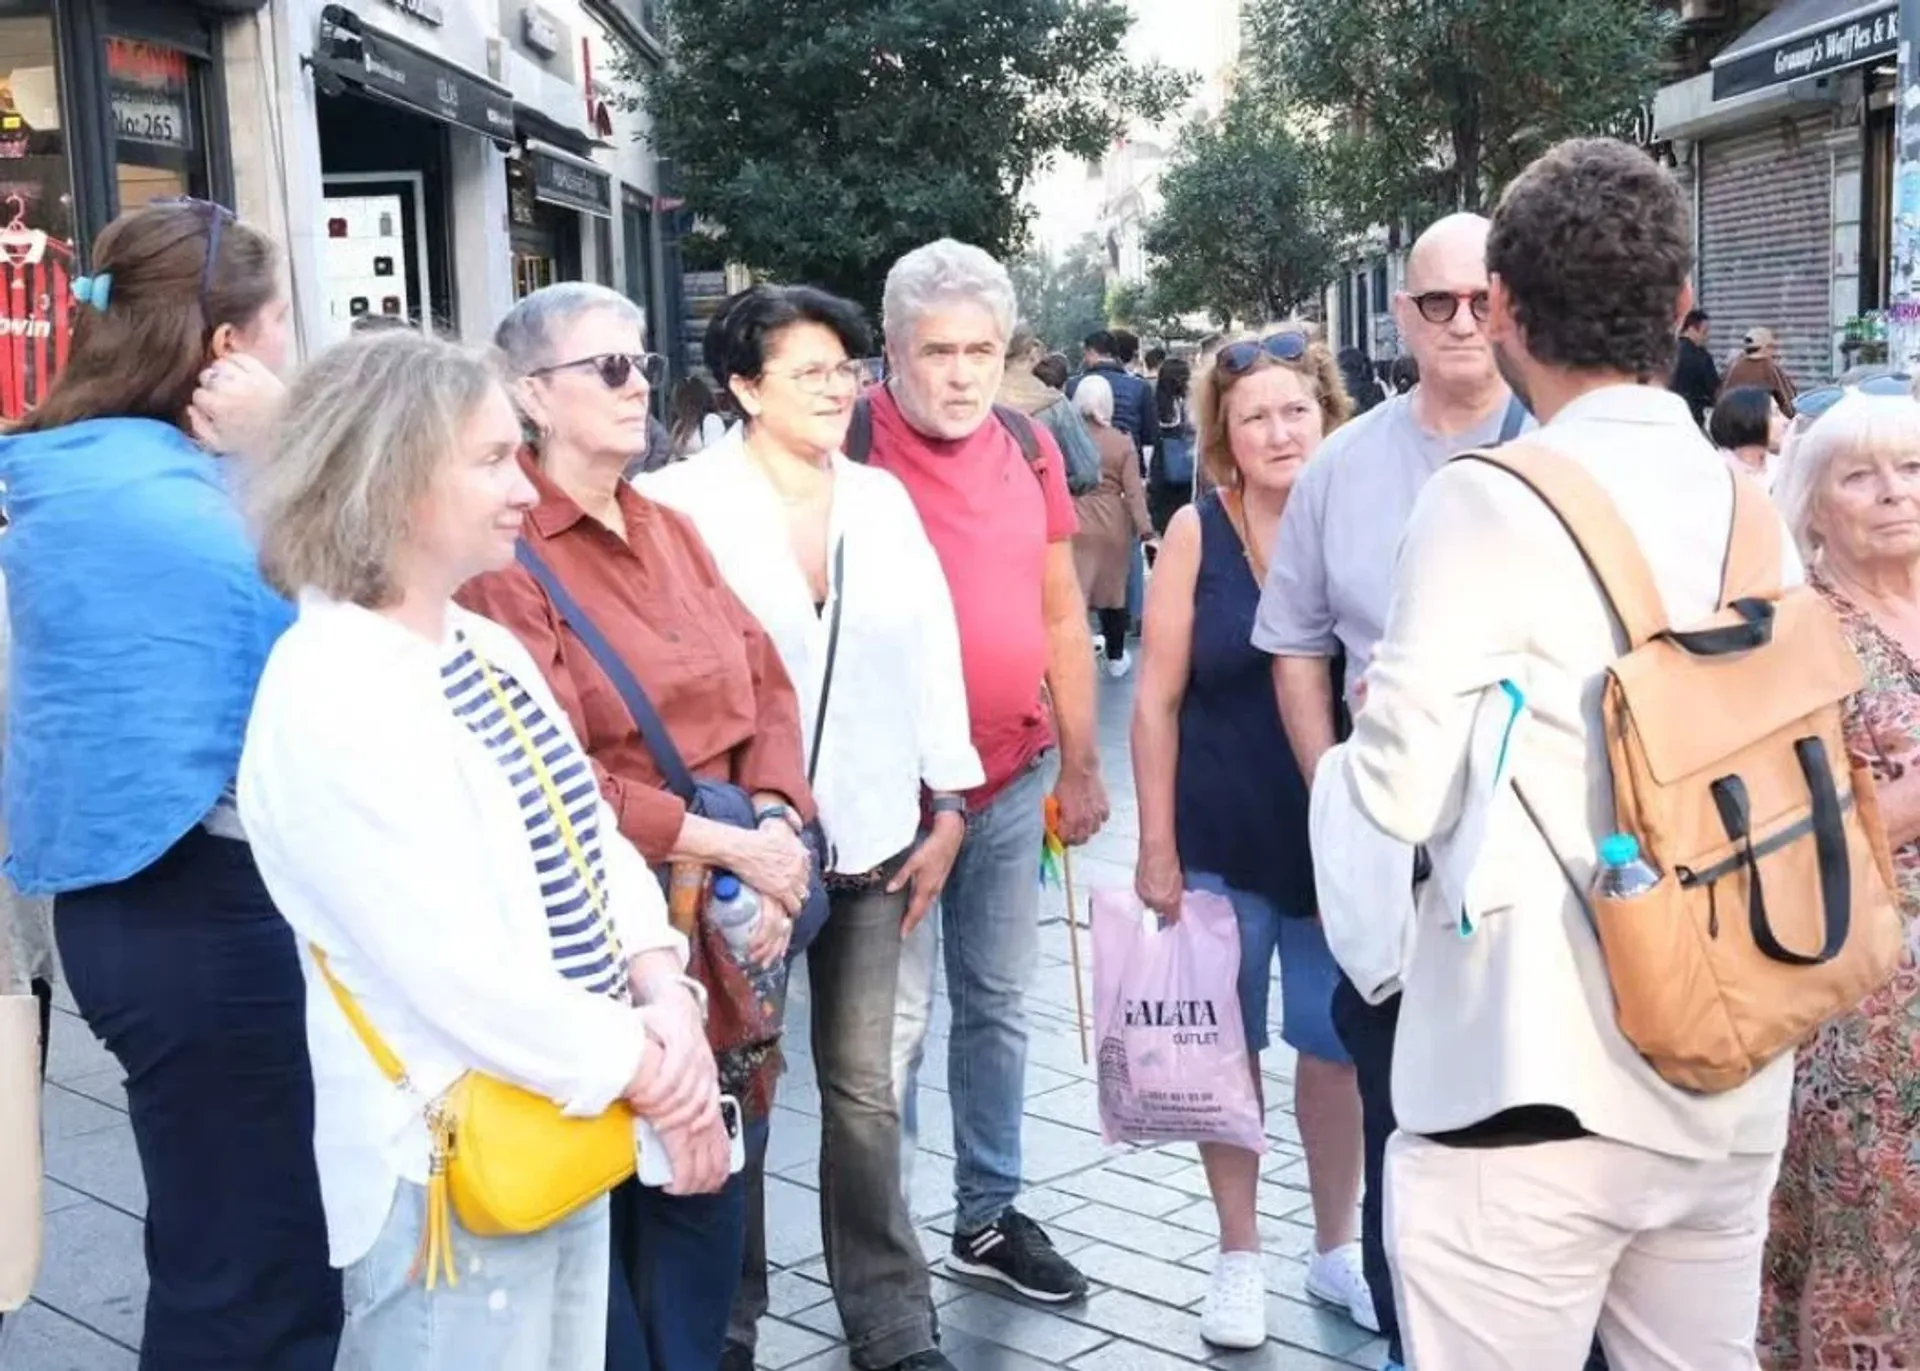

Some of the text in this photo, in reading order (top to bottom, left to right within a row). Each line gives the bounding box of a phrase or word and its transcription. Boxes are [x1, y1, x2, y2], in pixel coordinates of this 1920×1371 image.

[1825, 24, 1872, 61] Waffles
[1873, 17, 1885, 44] &
[1887, 11, 1899, 40] K
[143, 112, 173, 140] 265
[1172, 1032, 1219, 1045] OUTLET
